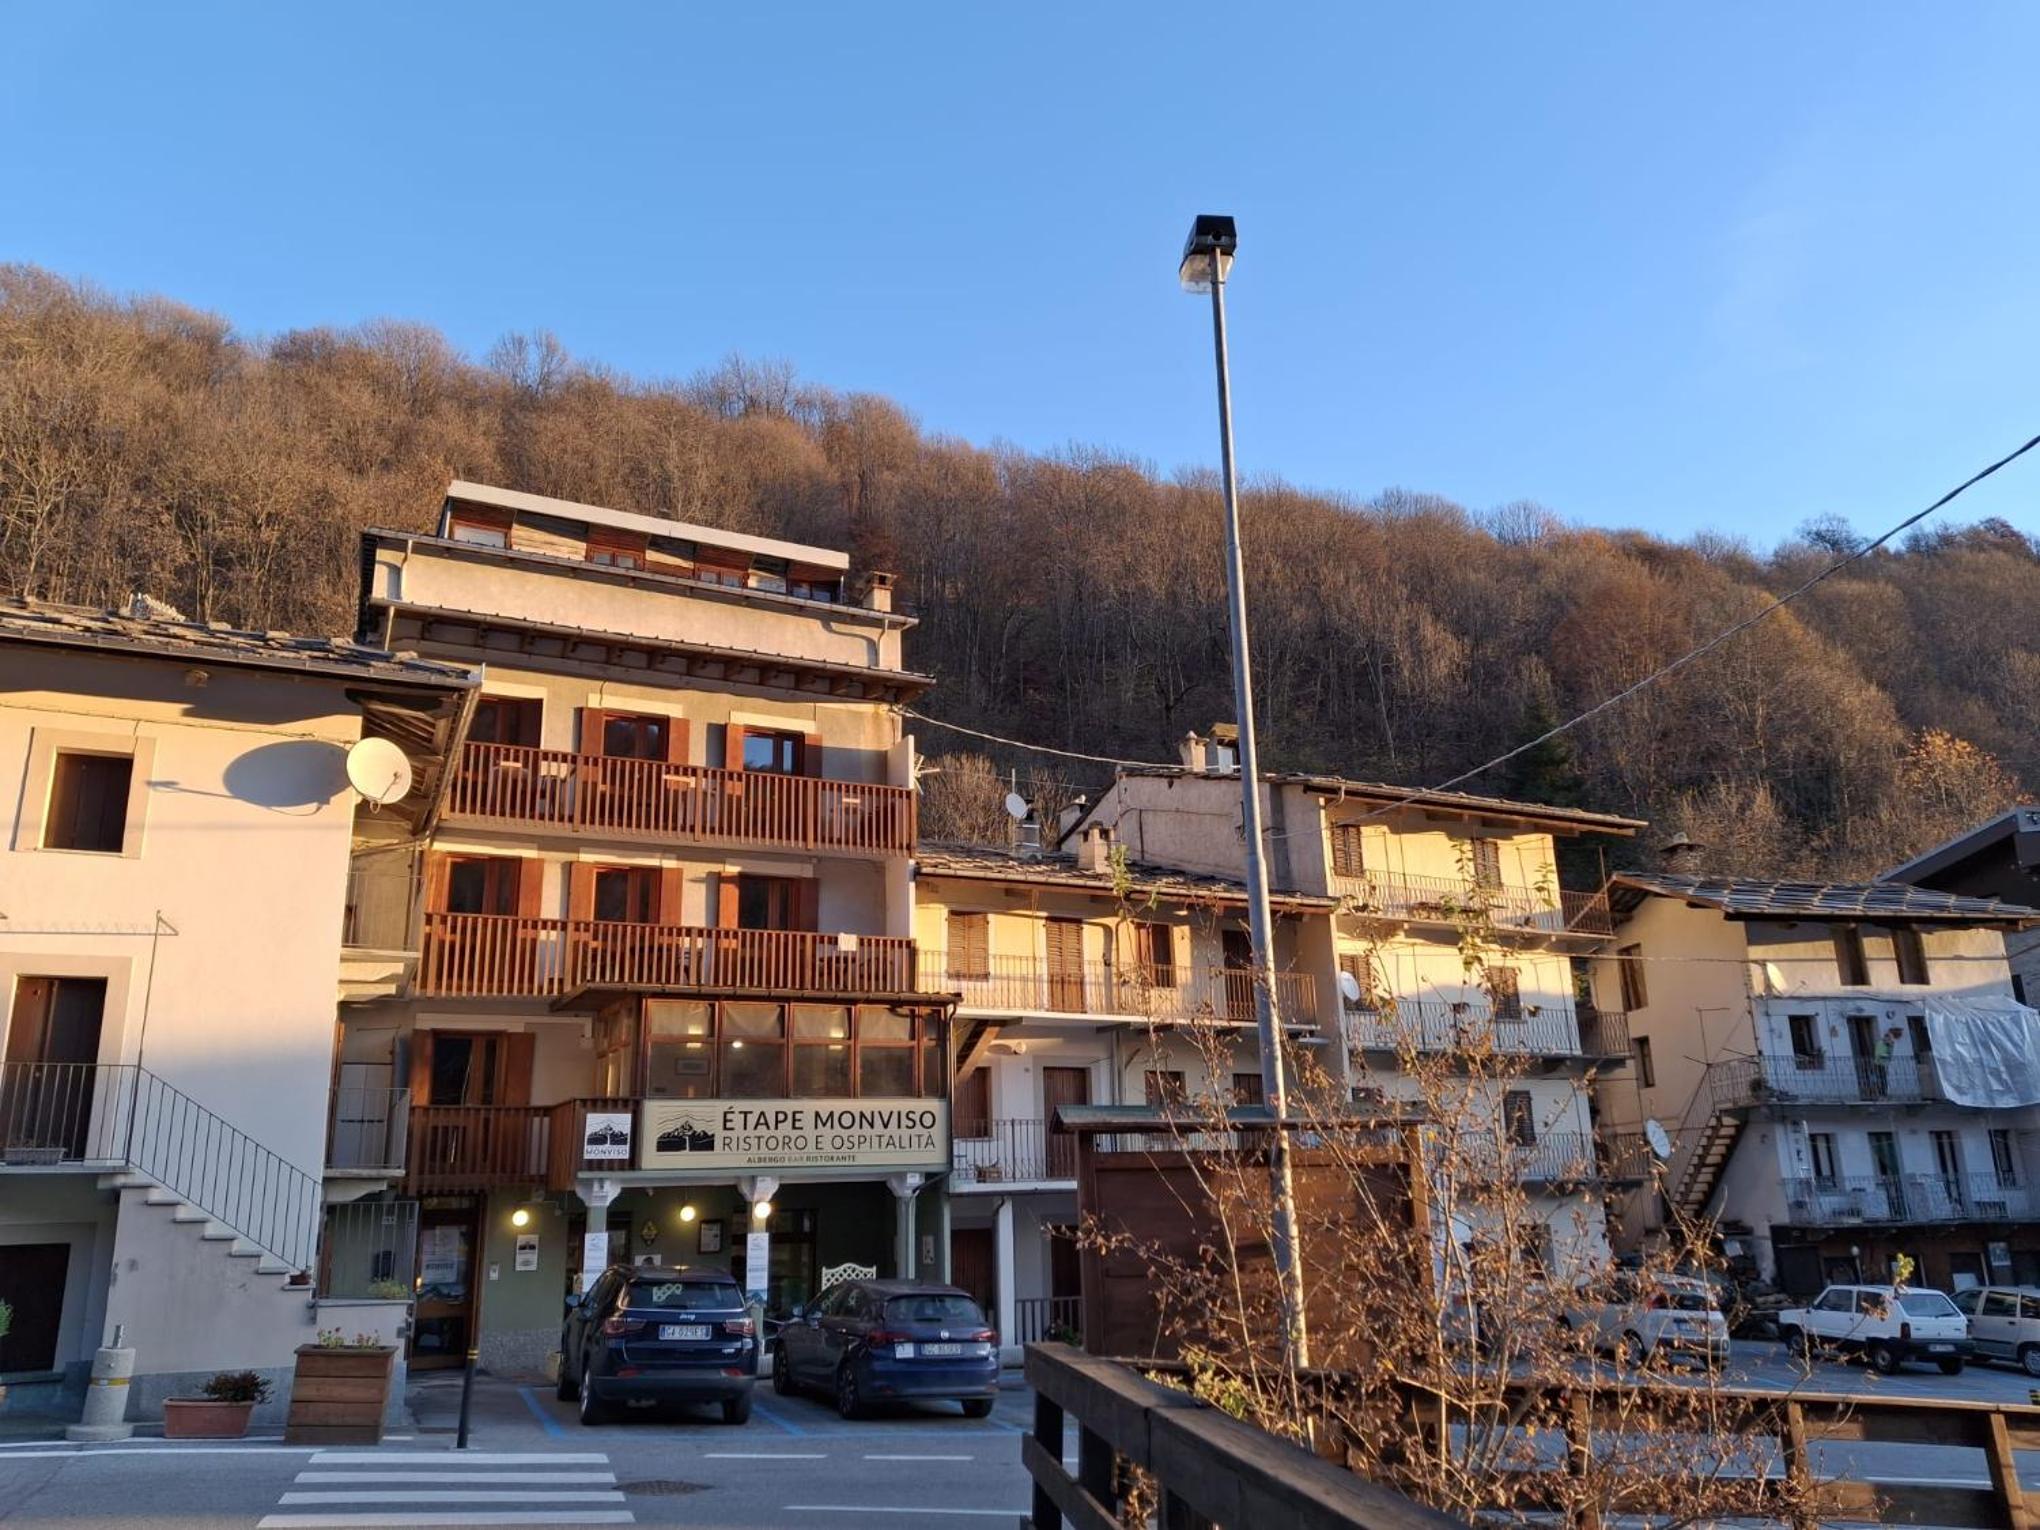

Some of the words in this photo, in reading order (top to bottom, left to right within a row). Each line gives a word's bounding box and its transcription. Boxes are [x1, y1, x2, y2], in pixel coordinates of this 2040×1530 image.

[722, 1106, 804, 1131] ÉTAPE
[814, 1110, 936, 1130] MONVISO
[722, 1135, 808, 1152] RISTORO
[815, 1135, 825, 1150] E
[831, 1131, 936, 1150] OSPITALITÀ
[586, 1147, 628, 1156] MONVISO
[746, 1156, 786, 1164] ALBERGO
[805, 1155, 857, 1163] RISTORANTE
